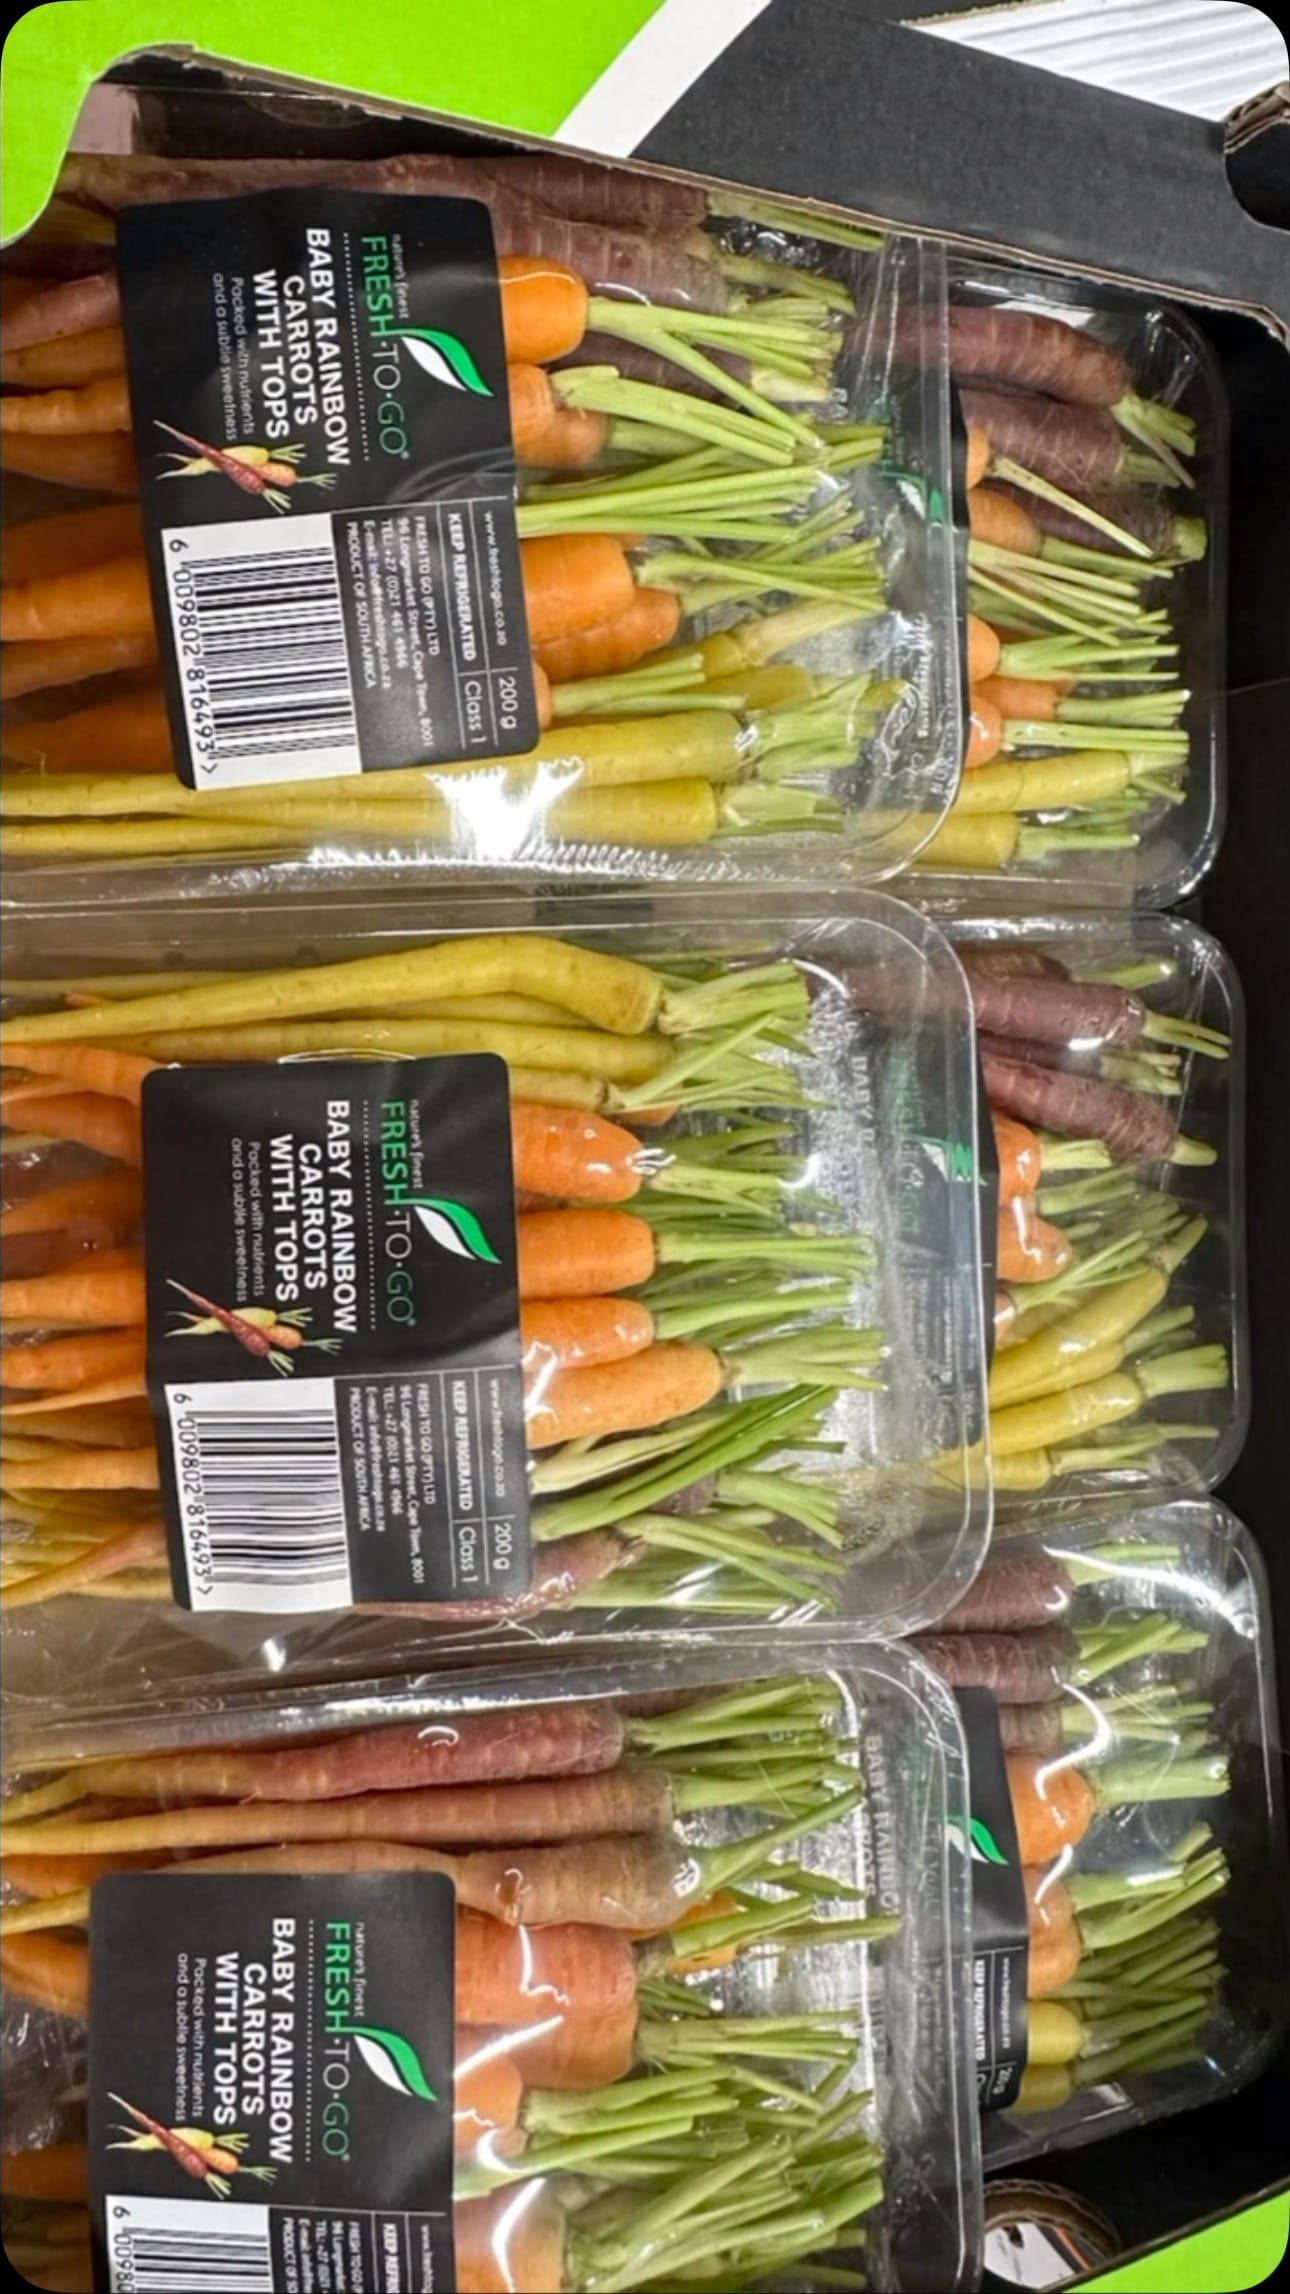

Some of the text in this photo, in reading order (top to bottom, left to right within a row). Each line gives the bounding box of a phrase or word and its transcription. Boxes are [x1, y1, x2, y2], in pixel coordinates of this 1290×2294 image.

[282, 275, 316, 425] CARROTS
[305, 228, 349, 464] BABY RAINBOW
[391, 234, 409, 318] nature's finest
[213, 273, 238, 440] and a subtle sweetness
[231, 278, 254, 434] Packed with nutrients
[254, 270, 289, 438] WITH TOPS
[170, 540, 214, 753] 6 009802 816493
[465, 681, 482, 730] Class
[499, 676, 516, 730] 200 g
[232, 1138, 250, 1302] and a subtle sweetness
[249, 1142, 267, 1296] Packed with nutrients
[270, 1134, 298, 1301] WITH TOPS
[299, 1144, 326, 1289] CARROTS
[327, 1100, 356, 1332] BABY RAINBOW
[410, 1100, 424, 1189] nature's finest
[174, 1394, 212, 1577] 6 009802 816493
[459, 1527, 476, 1570] Class
[494, 1523, 510, 1570] 200 g
[866, 1735, 890, 1804] BABY
[175, 1954, 189, 2121] and a subtle sweetness
[192, 1958, 206, 2117] Packed with nutrients
[214, 1952, 237, 2125] WITH TOPS
[242, 1963, 266, 2115] CARROTS
[270, 1918, 296, 2162] BABY RAINBOW
[353, 1922, 366, 2016] nature's finest
[113, 2205, 132, 2218] 6
